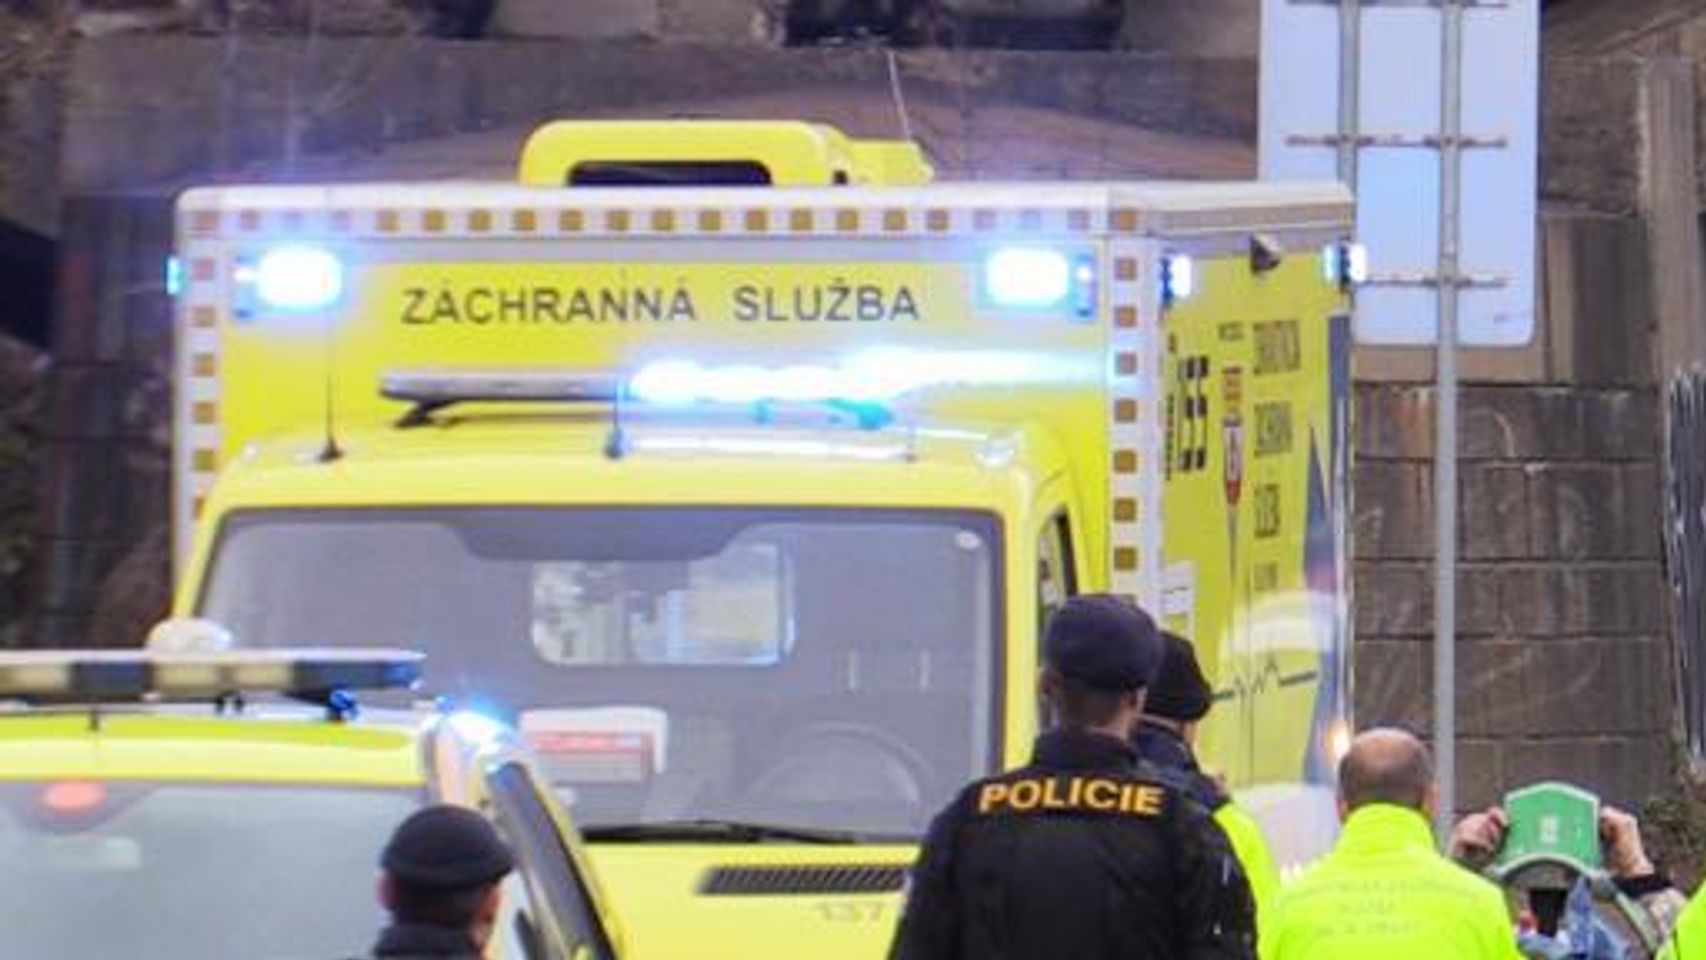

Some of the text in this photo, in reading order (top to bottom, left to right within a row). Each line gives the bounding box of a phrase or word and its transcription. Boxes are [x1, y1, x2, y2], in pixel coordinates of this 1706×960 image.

[401, 277, 920, 325] ZÁCHRANNÁ SLUŽBA
[979, 776, 1166, 815] POLICIE
